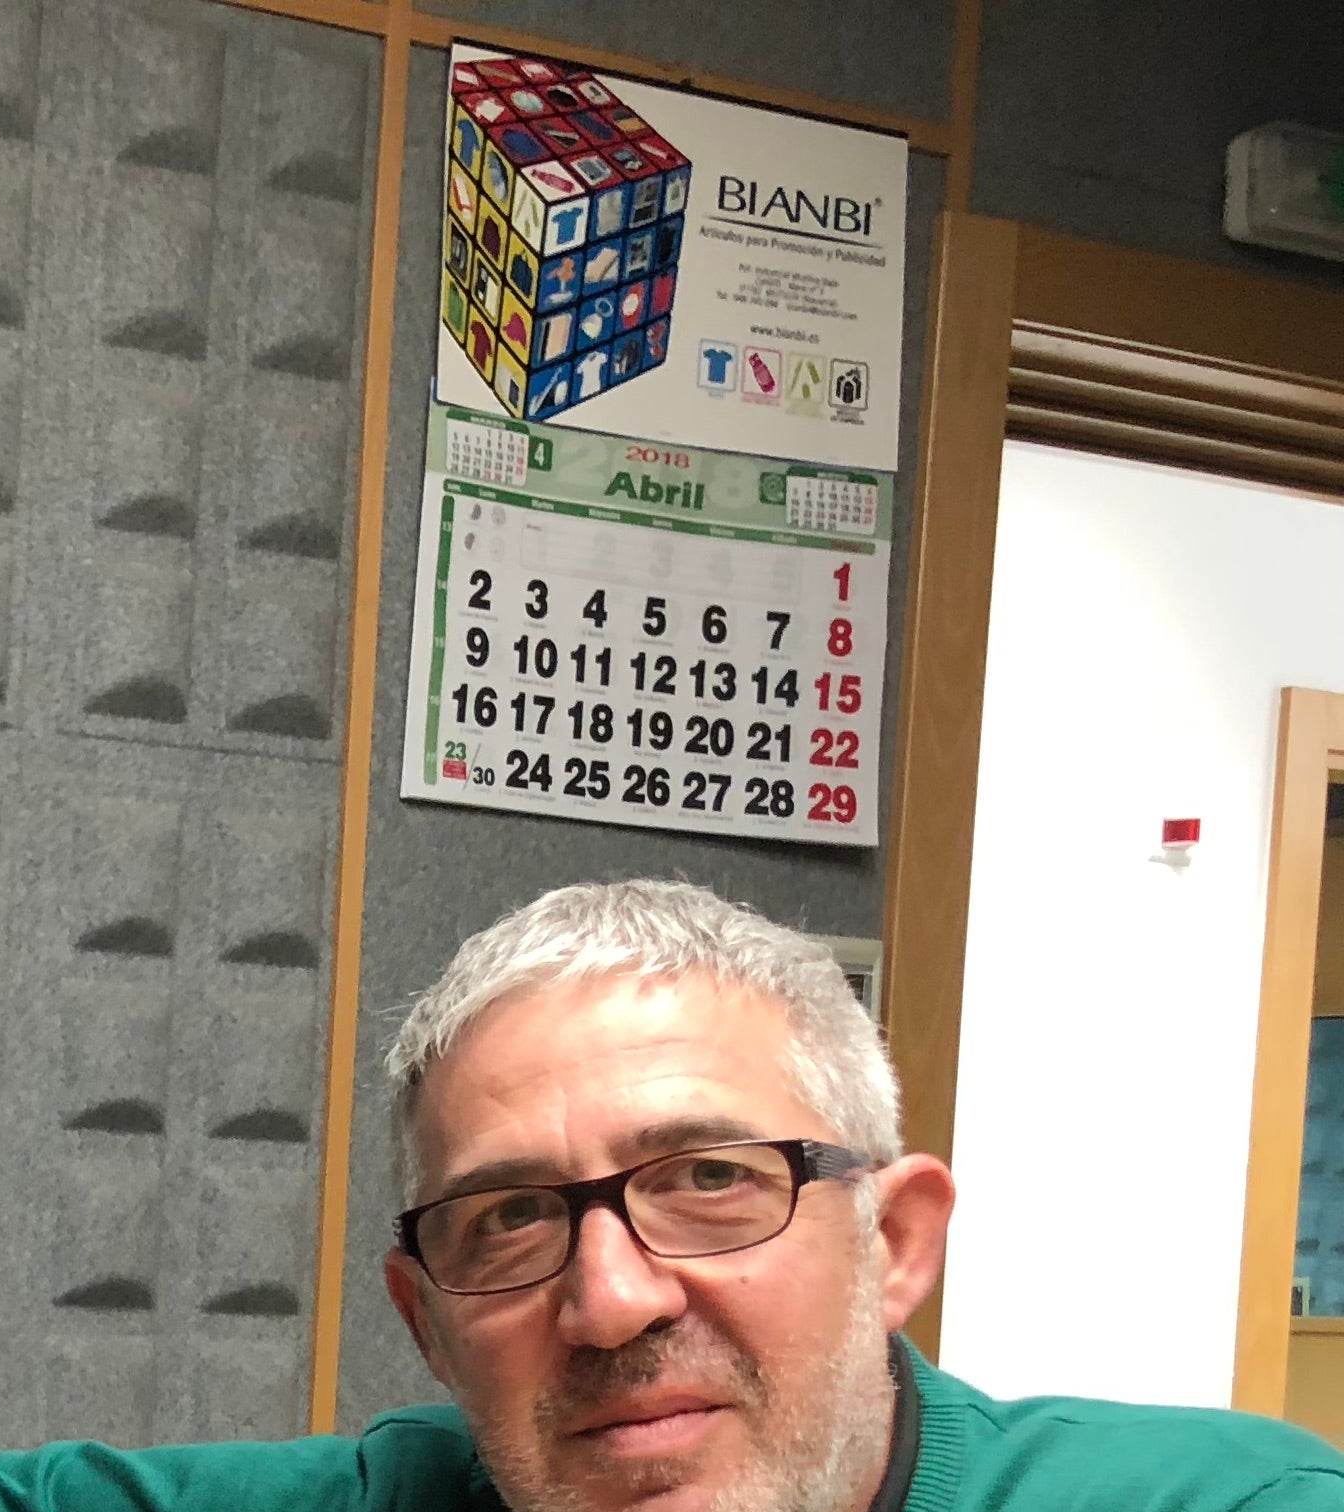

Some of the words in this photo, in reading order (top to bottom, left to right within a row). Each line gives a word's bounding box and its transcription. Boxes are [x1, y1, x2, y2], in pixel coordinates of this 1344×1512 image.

[717, 175, 872, 236] BIANBI
[534, 442, 545, 467] 4
[625, 445, 690, 469] 2018
[604, 471, 705, 511] Abril
[833, 562, 851, 602] 1
[469, 570, 492, 610] 2
[525, 579, 549, 619] 3
[583, 589, 608, 628] 4
[642, 596, 667, 636] 5
[702, 604, 728, 644] 6
[766, 611, 791, 650] 7
[827, 617, 853, 657] 8
[466, 627, 490, 667] 9
[513, 634, 559, 679] 10
[570, 644, 612, 687] 11
[630, 652, 677, 695] 12
[689, 660, 737, 702] 13
[752, 667, 800, 708] 14
[814, 671, 862, 714] 15
[452, 683, 498, 728] 16
[510, 691, 556, 735] 17
[567, 700, 614, 744] 18
[626, 708, 674, 751] 19
[684, 715, 735, 757] 20
[746, 722, 792, 763] 21
[809, 727, 860, 769] 22
[445, 740, 467, 760] 23
[472, 766, 495, 786] 30
[505, 749, 553, 793] 24
[563, 757, 611, 800] 25
[622, 764, 671, 807] 26
[681, 772, 732, 813] 27
[744, 777, 795, 819] 28
[807, 783, 857, 824] 29
